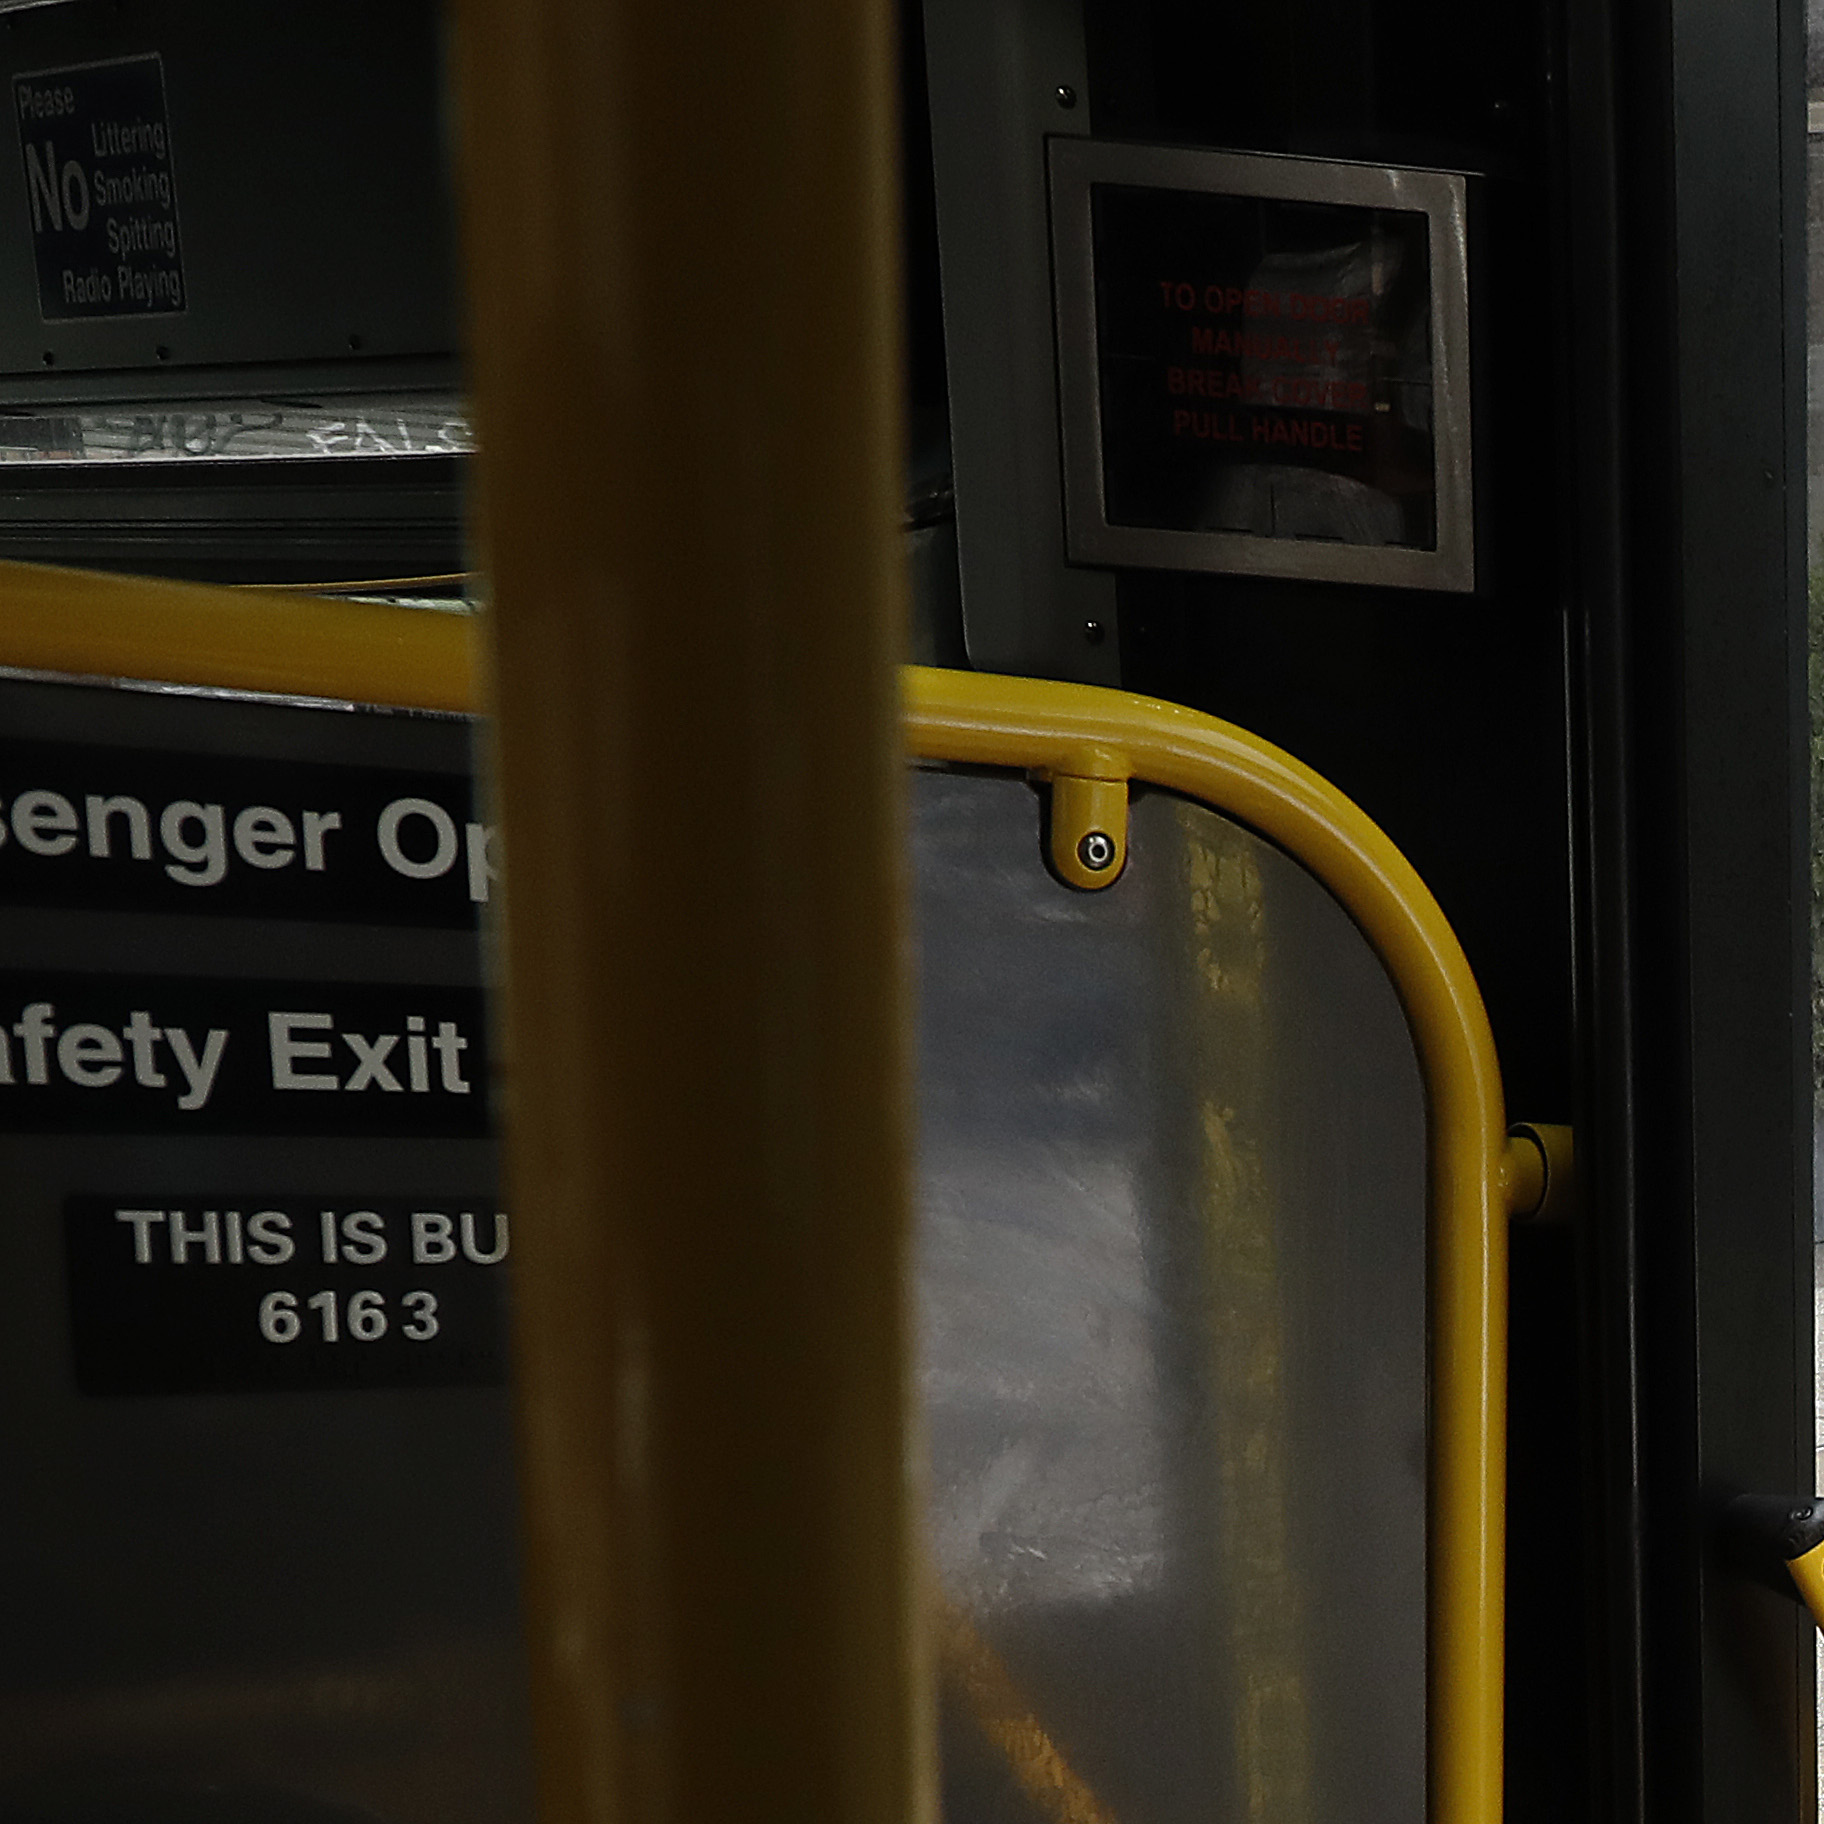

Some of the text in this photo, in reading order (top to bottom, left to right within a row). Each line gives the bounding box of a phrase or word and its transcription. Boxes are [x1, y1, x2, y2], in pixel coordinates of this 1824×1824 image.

[18, 83, 75, 120] Please
[91, 119, 166, 161] Littering
[25, 140, 90, 232] No
[93, 168, 172, 212] Smoking
[106, 215, 177, 260] Spitting
[61, 263, 182, 309] Radio Playing
[1160, 280, 1370, 325] TO OPEN DOOR
[1192, 327, 1340, 363] MANUALLY
[1167, 366, 1368, 409] BREAK COVER
[1173, 410, 1364, 453] PULL HANDLE
[0, 786, 344, 888] enger
[267, 1009, 473, 1096] Exit
[114, 1207, 512, 1267] THIS IS BU
[258, 1289, 440, 1345] 6163
